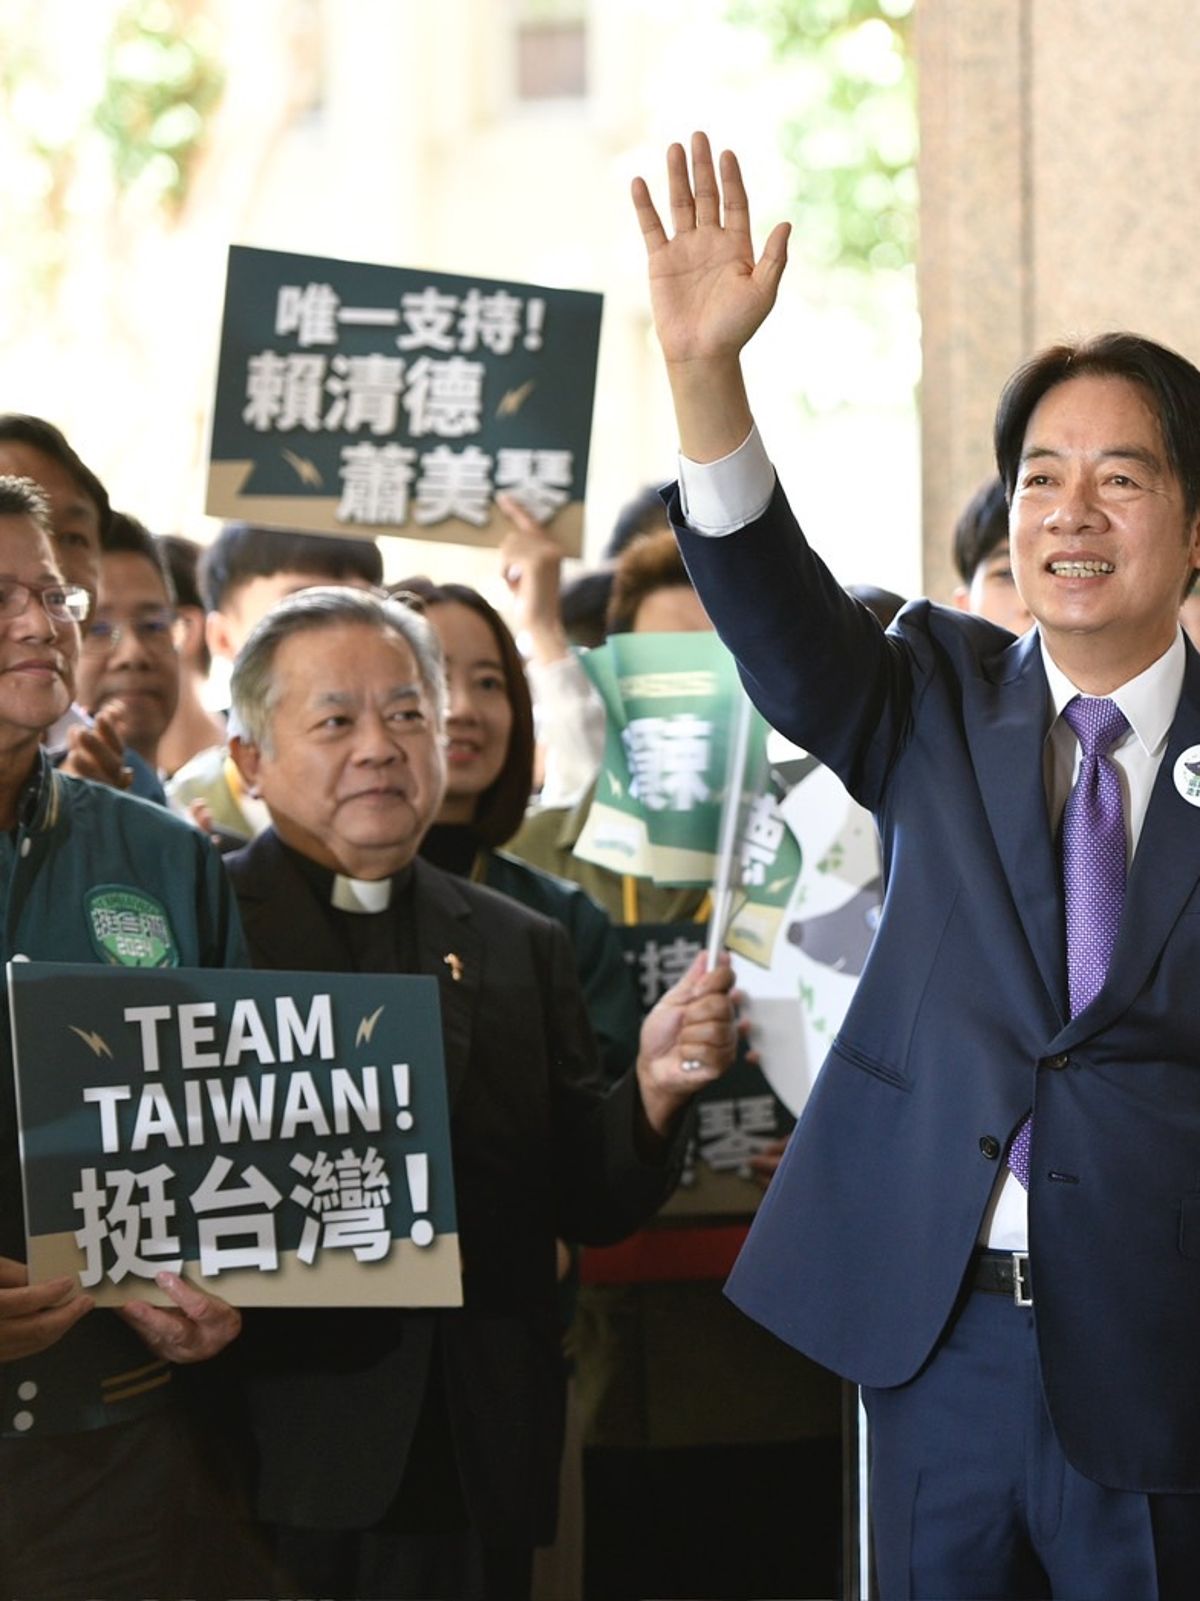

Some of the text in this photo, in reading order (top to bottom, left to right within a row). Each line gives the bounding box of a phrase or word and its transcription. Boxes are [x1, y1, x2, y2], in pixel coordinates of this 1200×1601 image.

[274, 282, 546, 355] 唯一支持!
[242, 349, 486, 438] 賴清德
[335, 440, 574, 528] 蕭美琴
[124, 993, 335, 1072] TEAM
[83, 1063, 415, 1154] TAIWAN!
[73, 1146, 435, 1288] 挺台灣!
